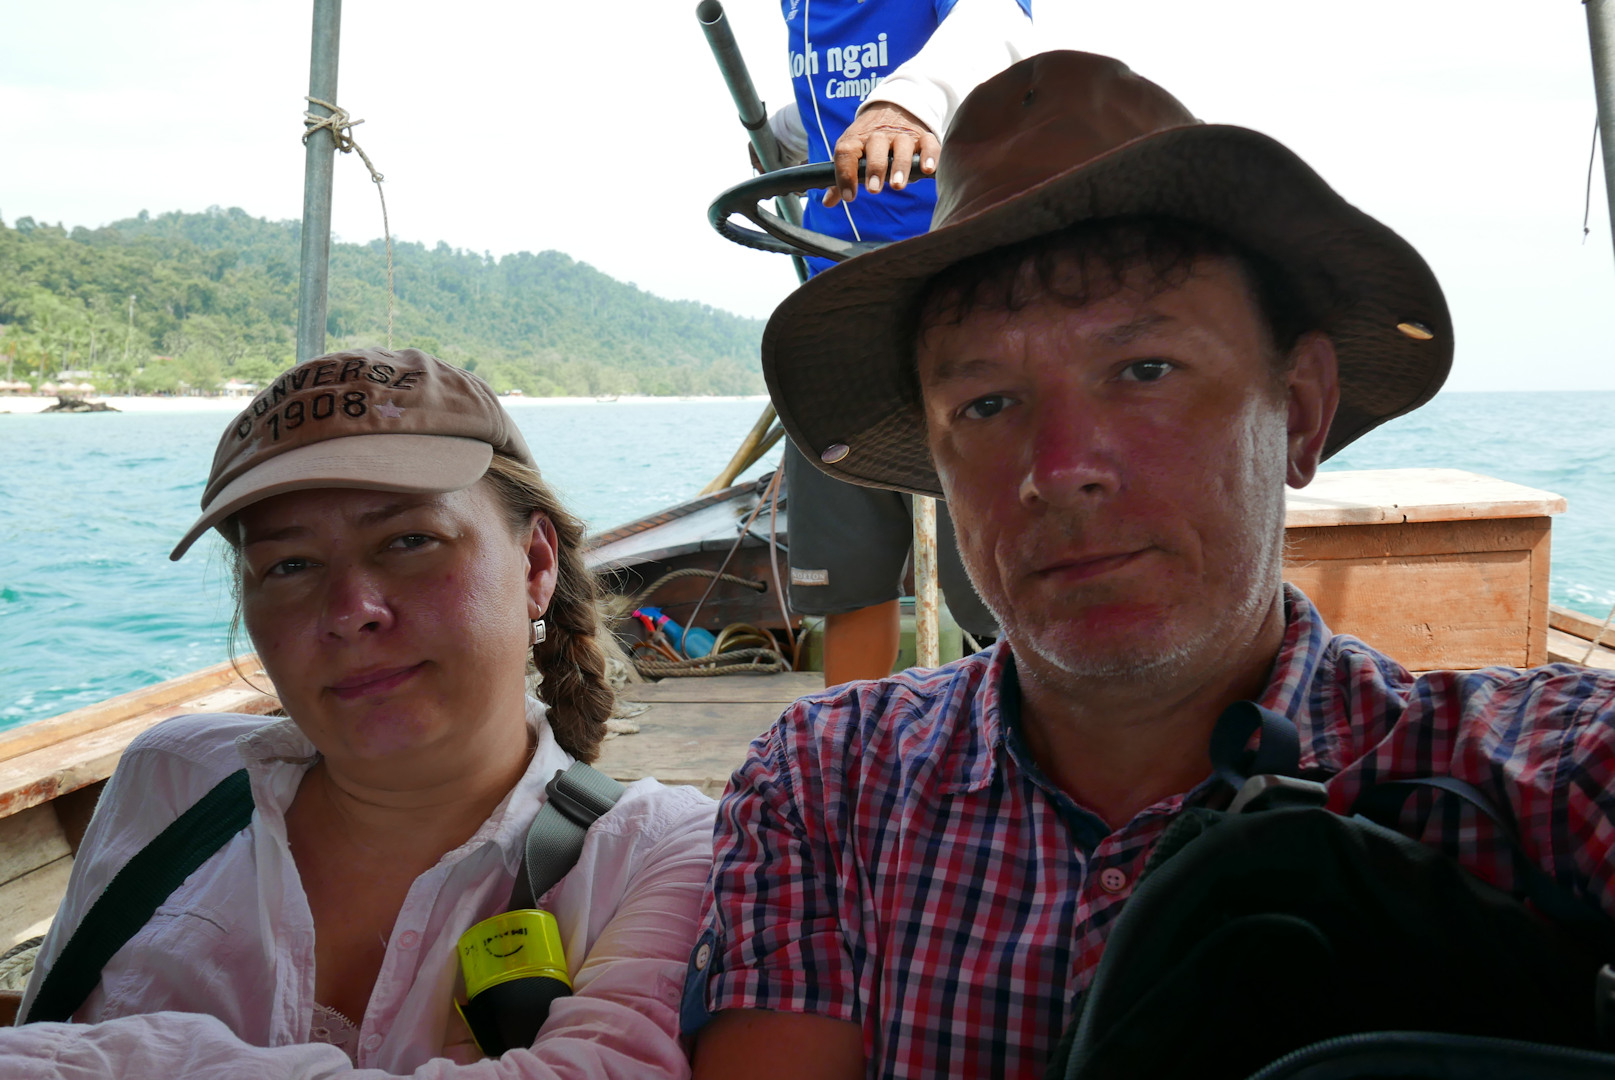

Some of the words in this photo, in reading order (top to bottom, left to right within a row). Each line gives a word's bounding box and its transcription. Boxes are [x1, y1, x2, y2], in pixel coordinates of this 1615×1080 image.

[827, 33, 888, 78] ngai
[237, 359, 426, 440] CONVERSE
[267, 391, 367, 441] 1908
